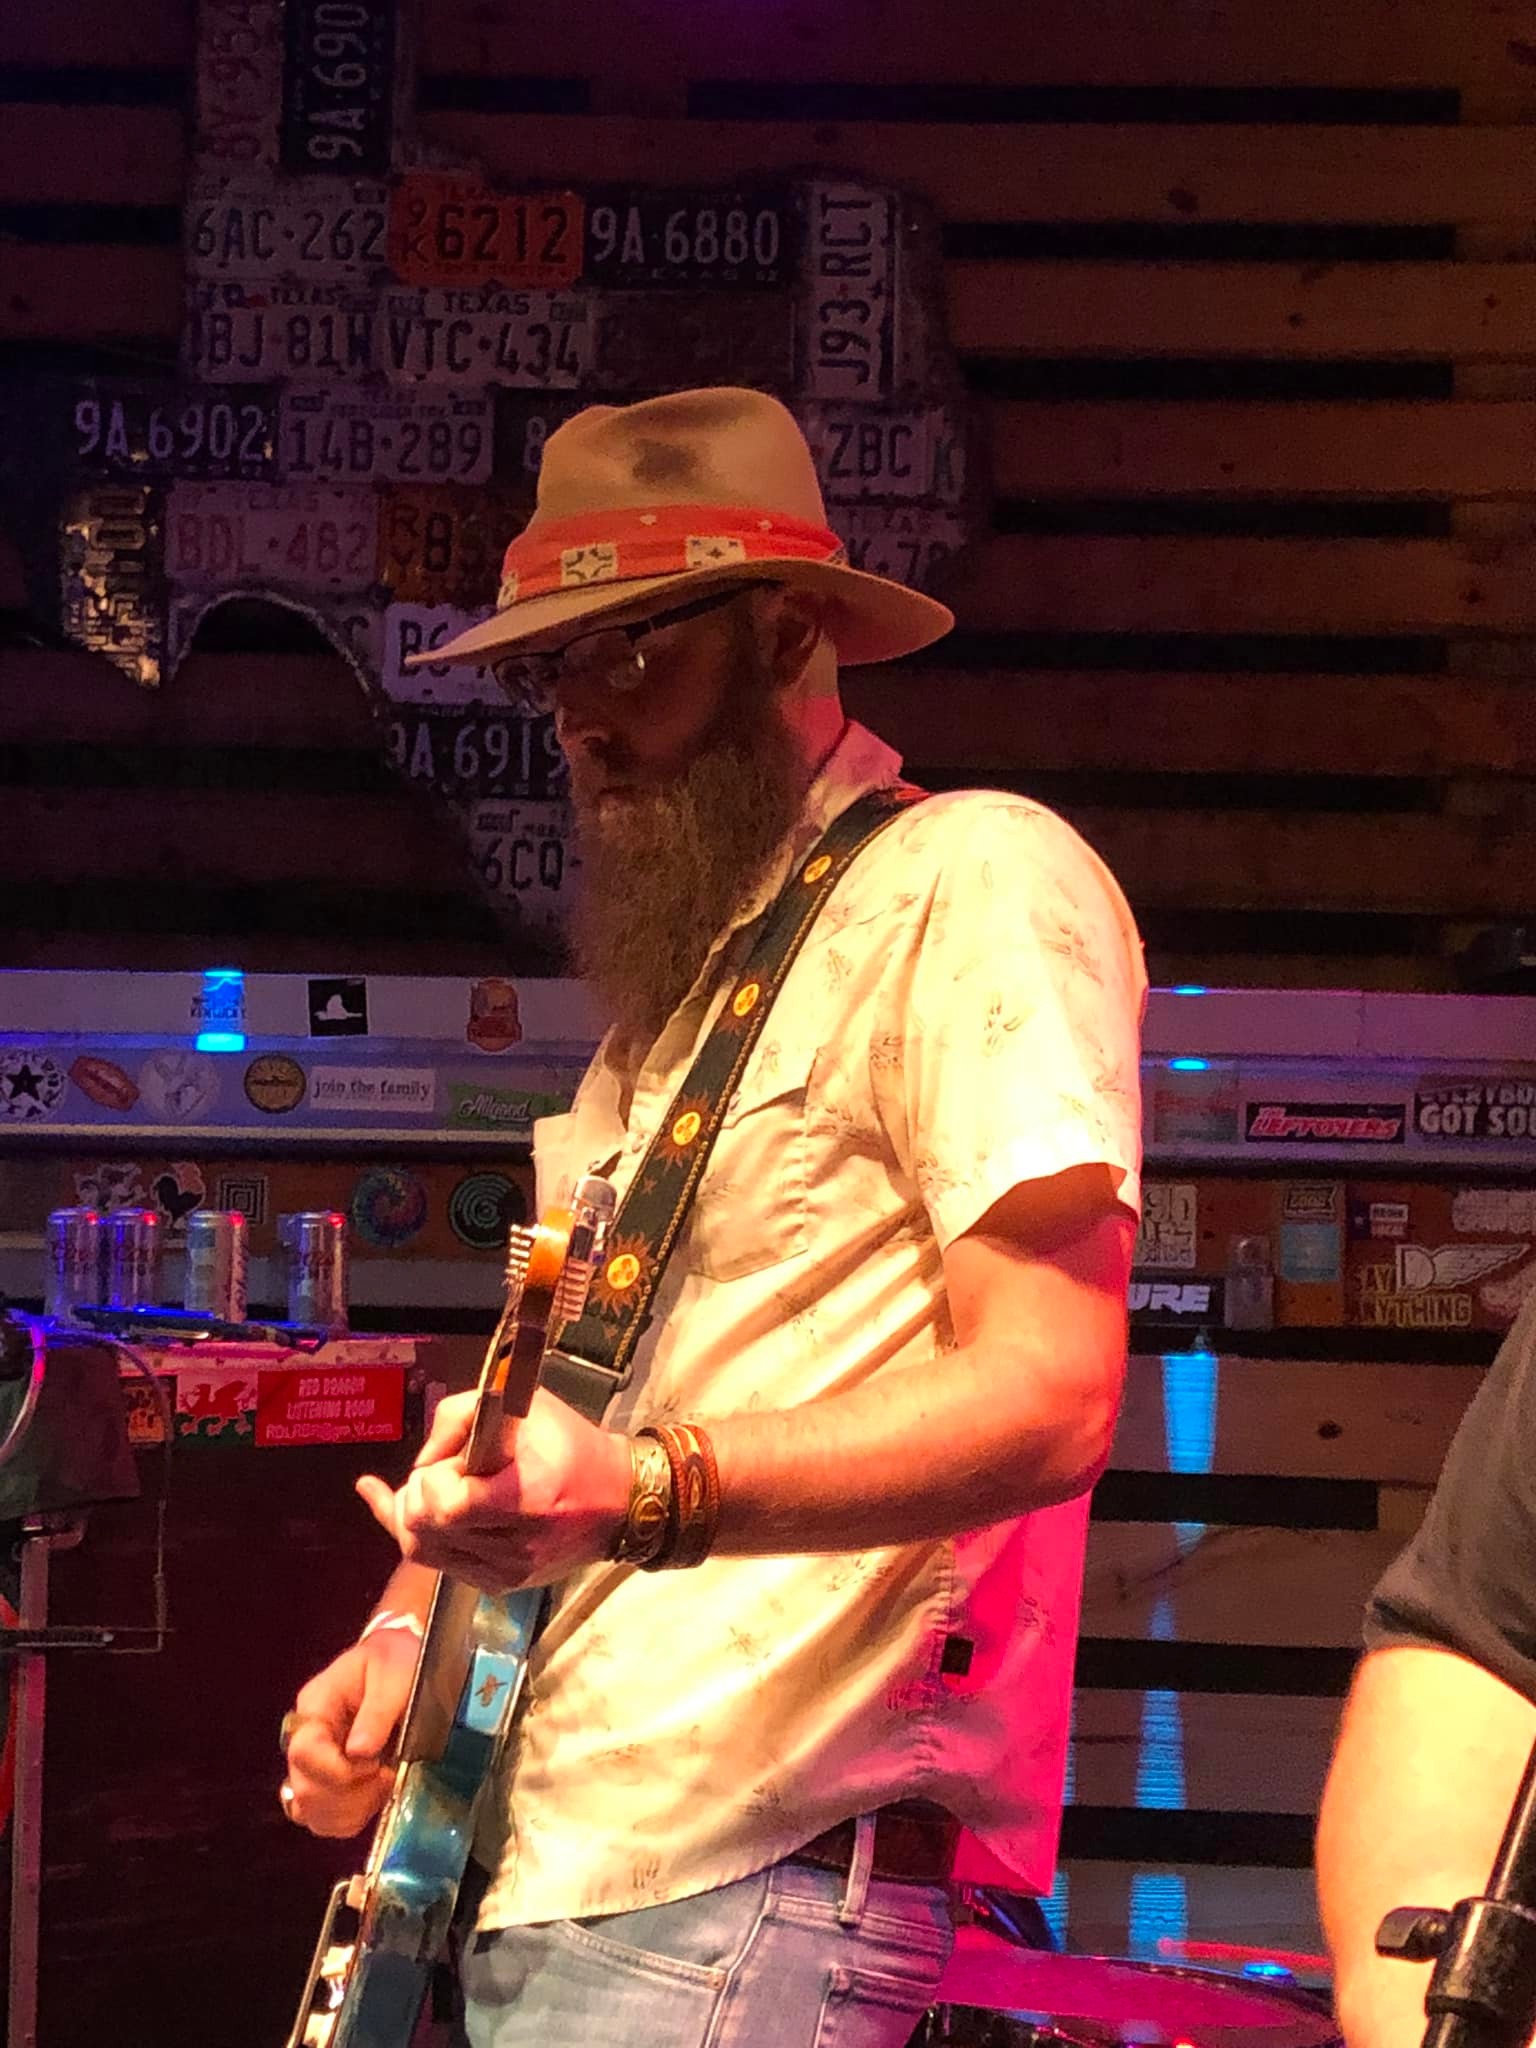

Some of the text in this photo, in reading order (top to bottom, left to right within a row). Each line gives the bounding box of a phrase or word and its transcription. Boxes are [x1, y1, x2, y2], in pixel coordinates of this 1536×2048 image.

[437, 205, 569, 264] 6212
[445, 293, 529, 315] TEXAS
[828, 423, 912, 478] ZBC
[313, 1079, 430, 1101] join the family
[1420, 1103, 1479, 1134] GOT
